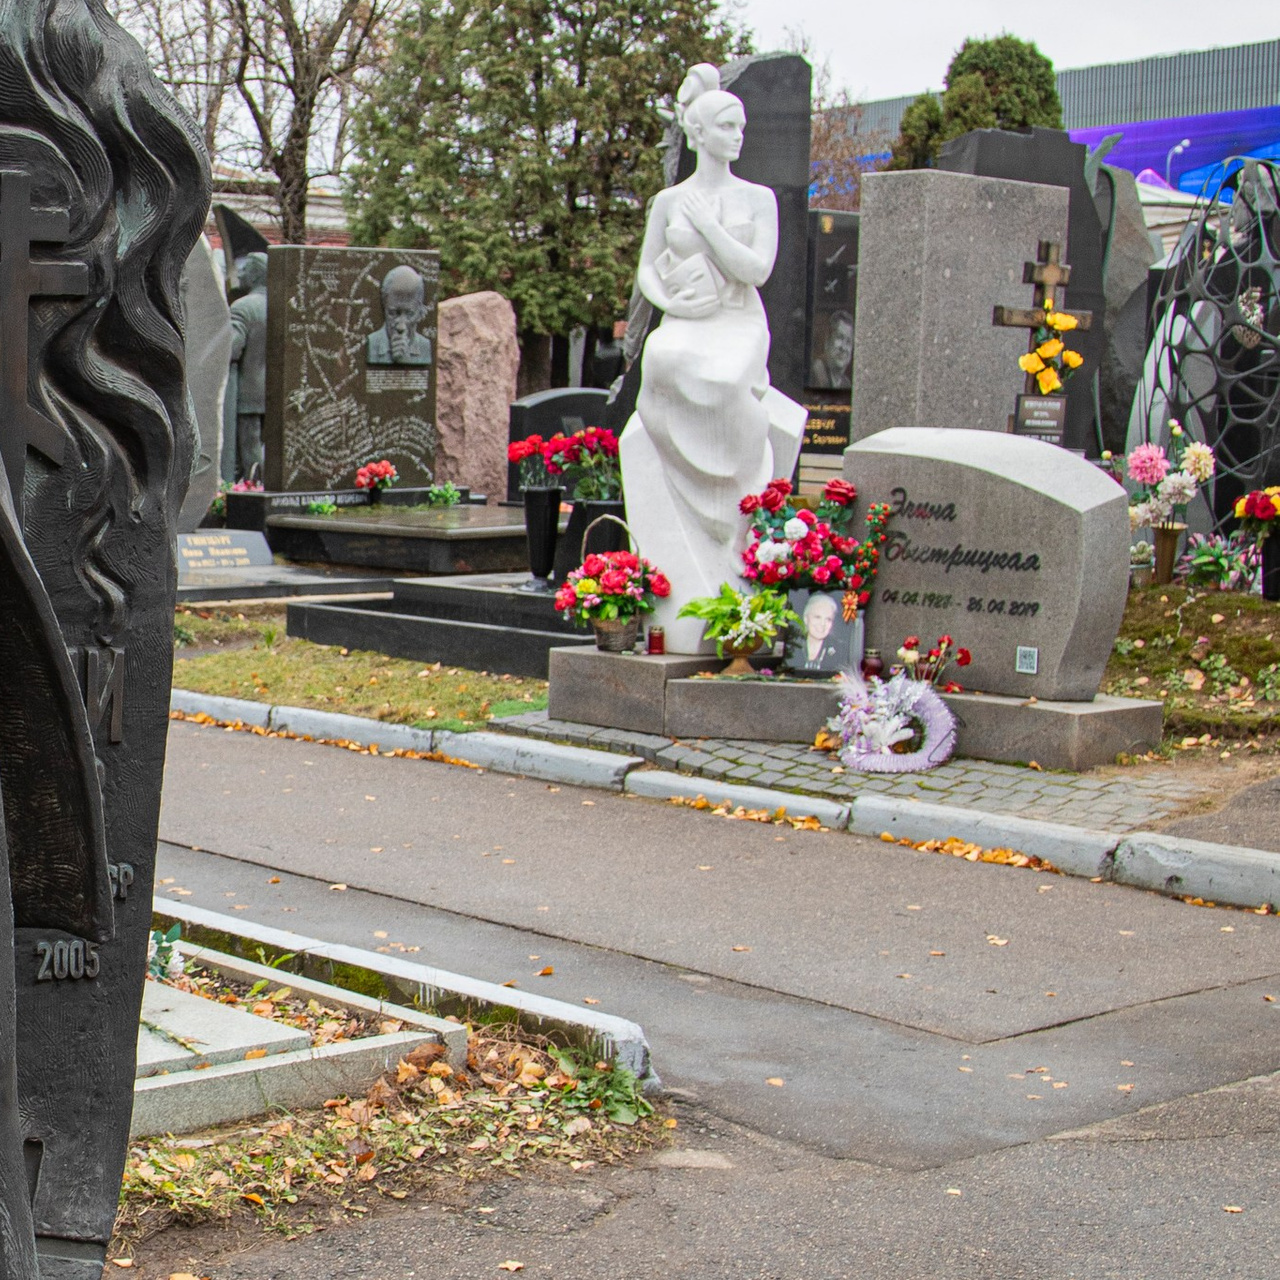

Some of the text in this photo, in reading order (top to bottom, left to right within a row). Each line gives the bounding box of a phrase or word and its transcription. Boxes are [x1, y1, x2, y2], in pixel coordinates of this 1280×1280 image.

[888, 487, 957, 521] Элина
[883, 530, 1041, 573] Быстрицкая
[37, 940, 100, 980] 2005
